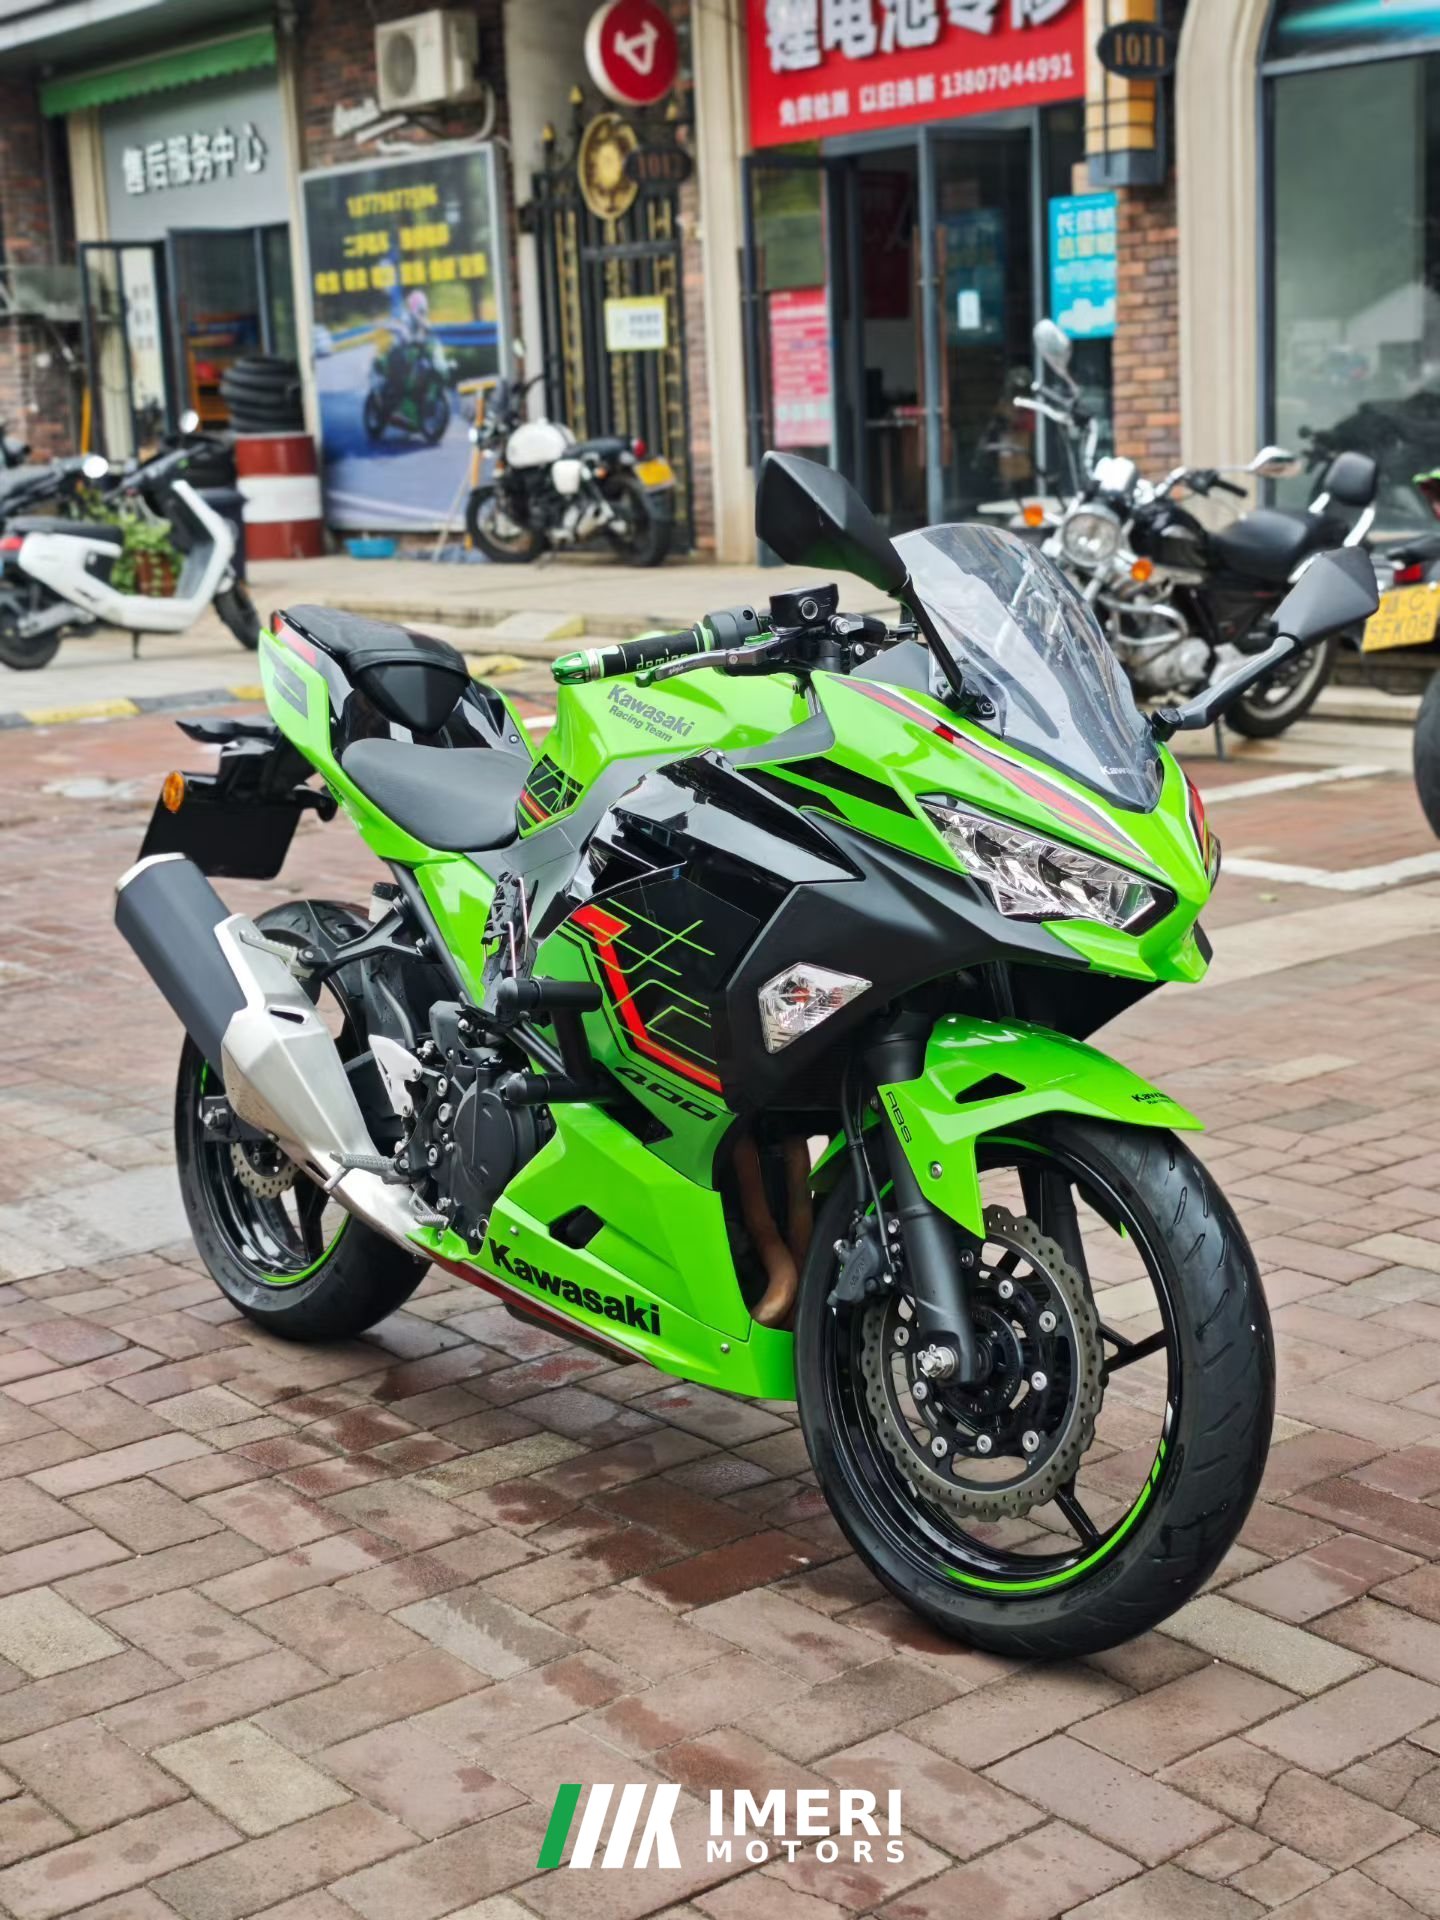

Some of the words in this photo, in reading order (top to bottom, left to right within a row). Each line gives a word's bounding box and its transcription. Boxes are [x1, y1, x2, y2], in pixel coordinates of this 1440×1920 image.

[942, 53, 1073, 98] 13807044991
[1114, 32, 1165, 68] 1011
[122, 122, 265, 194] 售后服务中心
[608, 684, 695, 736] Kawasaki
[609, 705, 643, 729] Racing
[645, 722, 672, 742] Team
[615, 1067, 718, 1121] 400
[886, 1091, 912, 1143] ABS
[489, 1238, 660, 1336] Kawasaki
